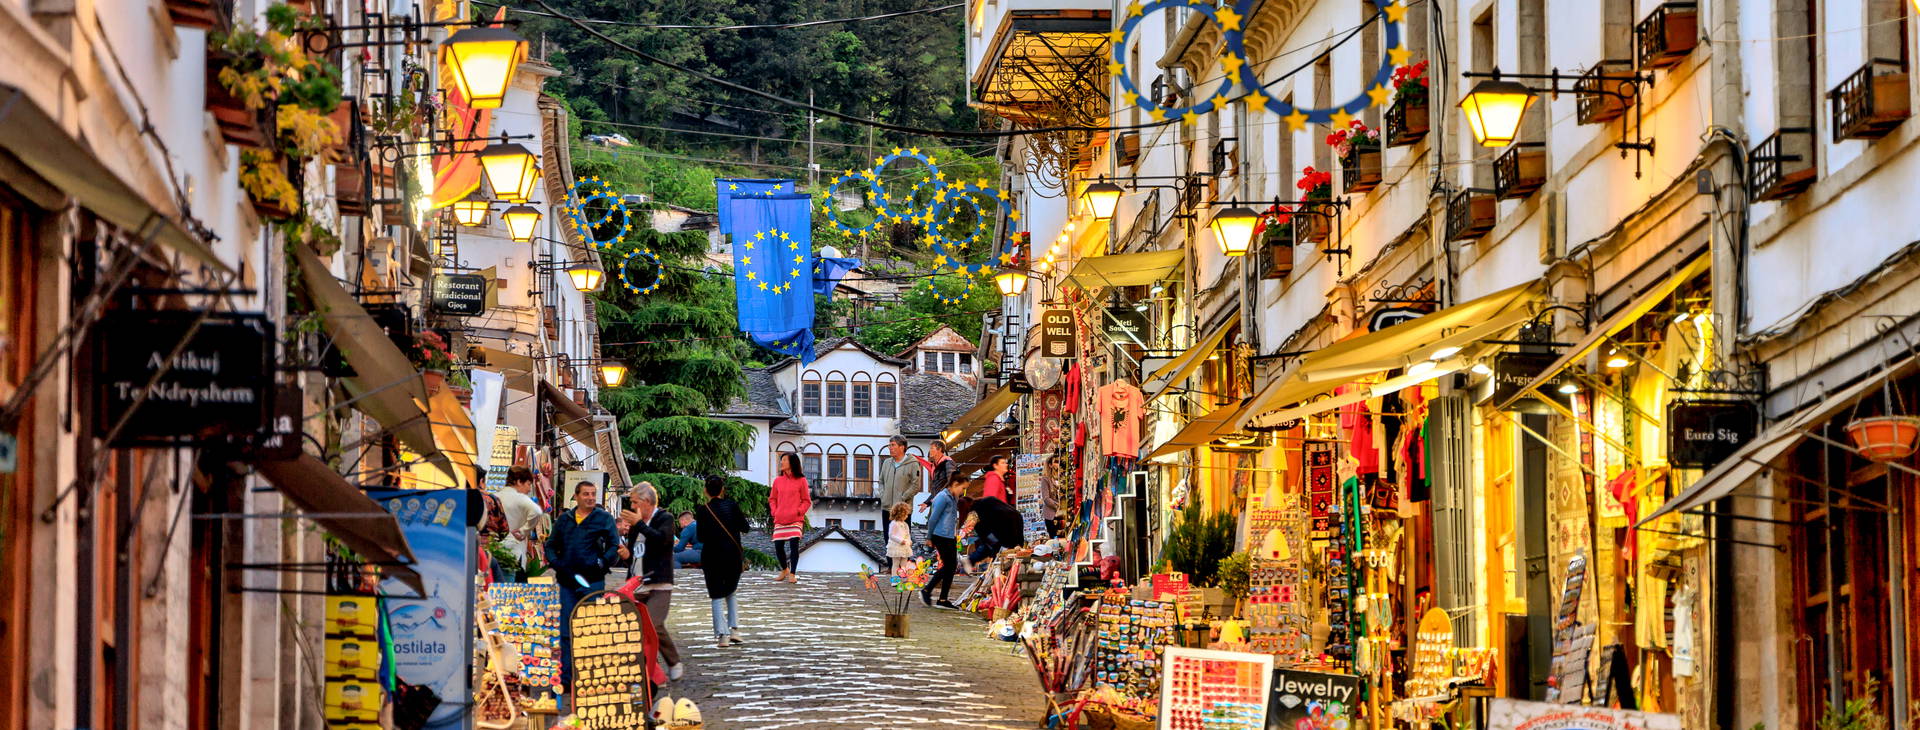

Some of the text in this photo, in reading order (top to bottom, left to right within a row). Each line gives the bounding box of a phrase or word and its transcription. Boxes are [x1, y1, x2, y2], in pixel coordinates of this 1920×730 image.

[437, 280, 480, 290] Restorant
[435, 291, 481, 300] Tradicional
[1047, 315, 1070, 324] OLD
[1046, 327, 1072, 336] WELL
[147, 351, 220, 375] Atikuj
[1684, 427, 1739, 445] Euro Sig
[393, 639, 446, 654] ostilata
[1274, 674, 1353, 704] Jewelry
